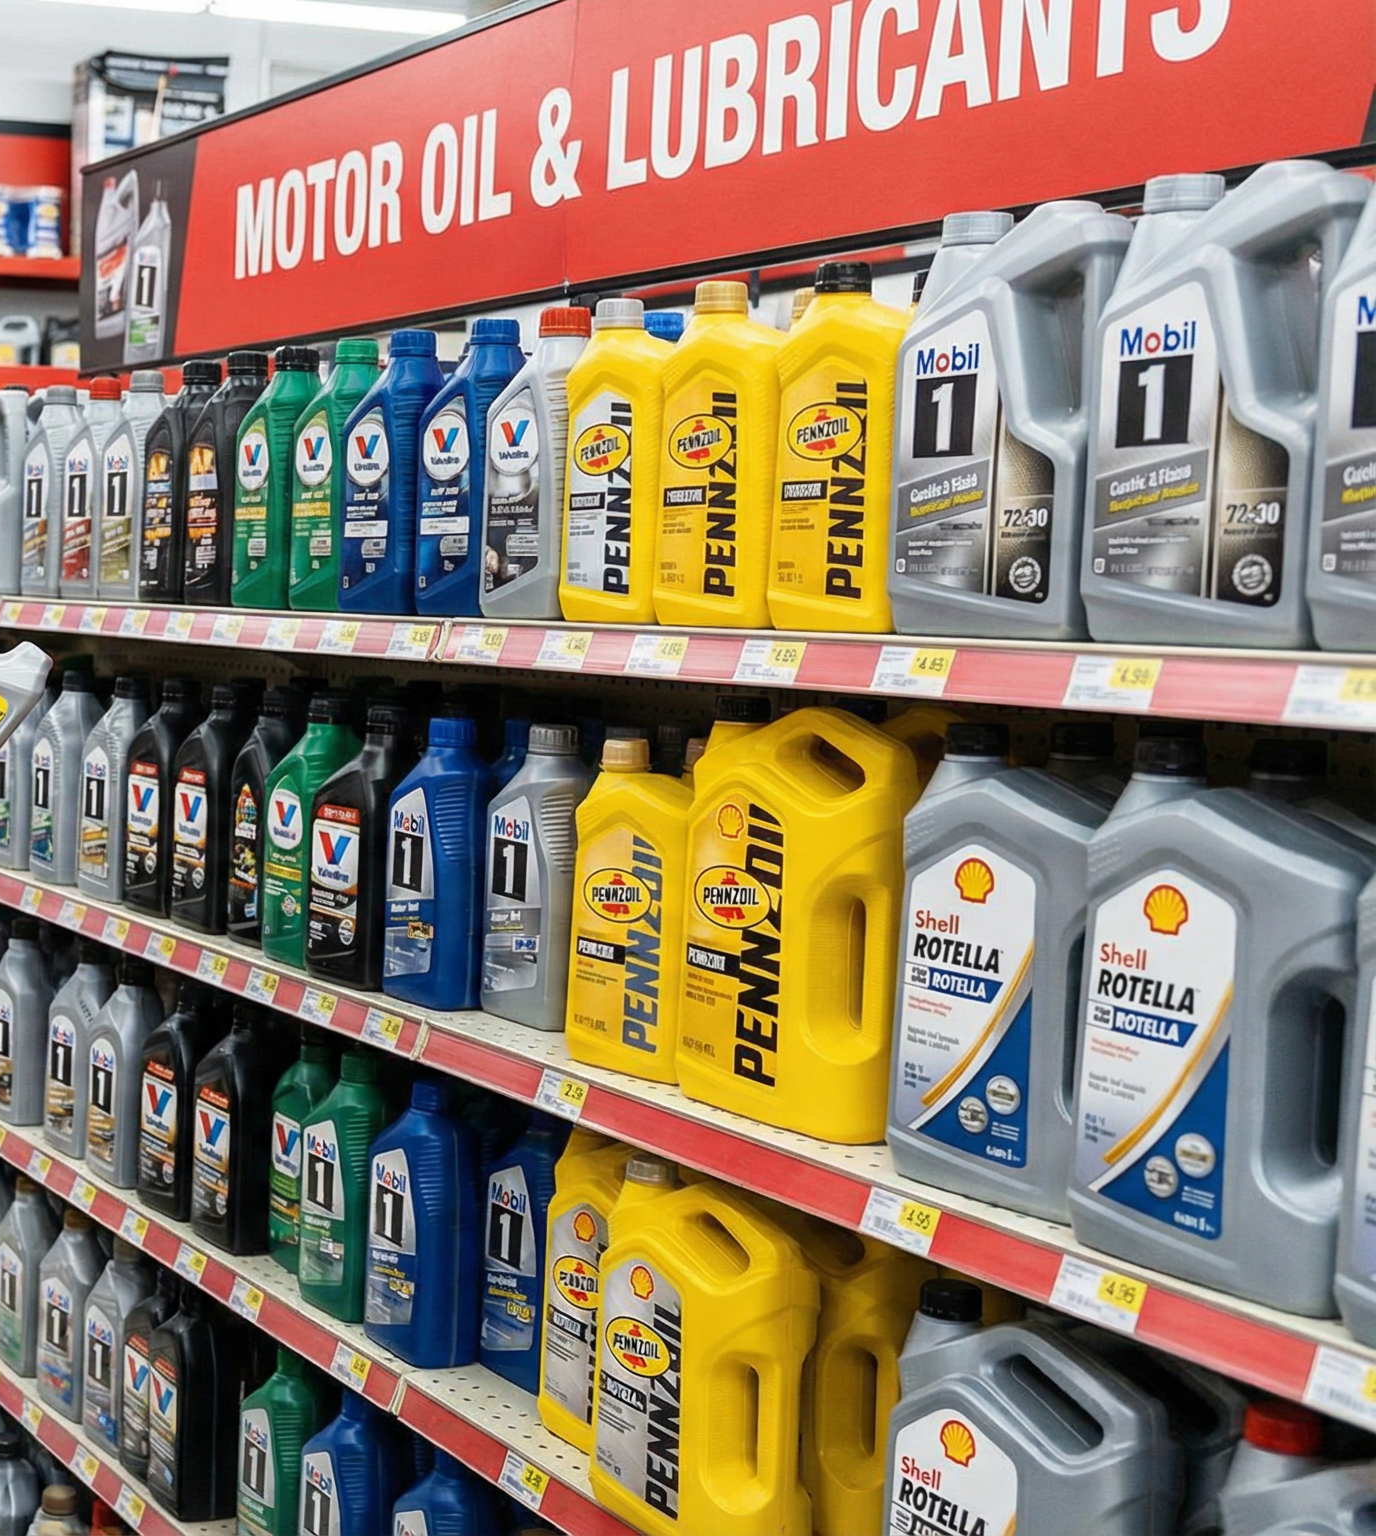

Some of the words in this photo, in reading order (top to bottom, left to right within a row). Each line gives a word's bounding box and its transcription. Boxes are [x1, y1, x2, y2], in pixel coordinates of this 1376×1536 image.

[235, 141, 403, 279] MOTOR
[421, 109, 511, 234] OIL
[530, 88, 582, 207] &
[916, 344, 980, 375] Mobil
[1120, 321, 1196, 356] Mobil
[931, 382, 954, 453] 1
[1138, 364, 1166, 442] 1
[603, 402, 632, 594] PENNZIL
[704, 392, 737, 597] PENNZIL
[826, 378, 867, 599] PENNZIL
[401, 837, 413, 885] 1
[503, 844, 515, 893] 1
[915, 910, 959, 934] Shell
[914, 933, 1000, 974] ROTELLA
[1100, 943, 1147, 970] Shell
[932, 972, 986, 999] ROTELLA
[1098, 969, 1195, 1014] ROTELLA
[1115, 1012, 1180, 1042] ROTELLA
[96, 1072, 105, 1106] 1
[314, 1161, 325, 1203] 1
[383, 1192, 393, 1238] 1
[499, 1213, 511, 1261] 1
[93, 1343, 102, 1379] 1
[249, 1447, 258, 1490] 1
[901, 1456, 941, 1490] Shell
[899, 1477, 985, 1536] ROTELLA
